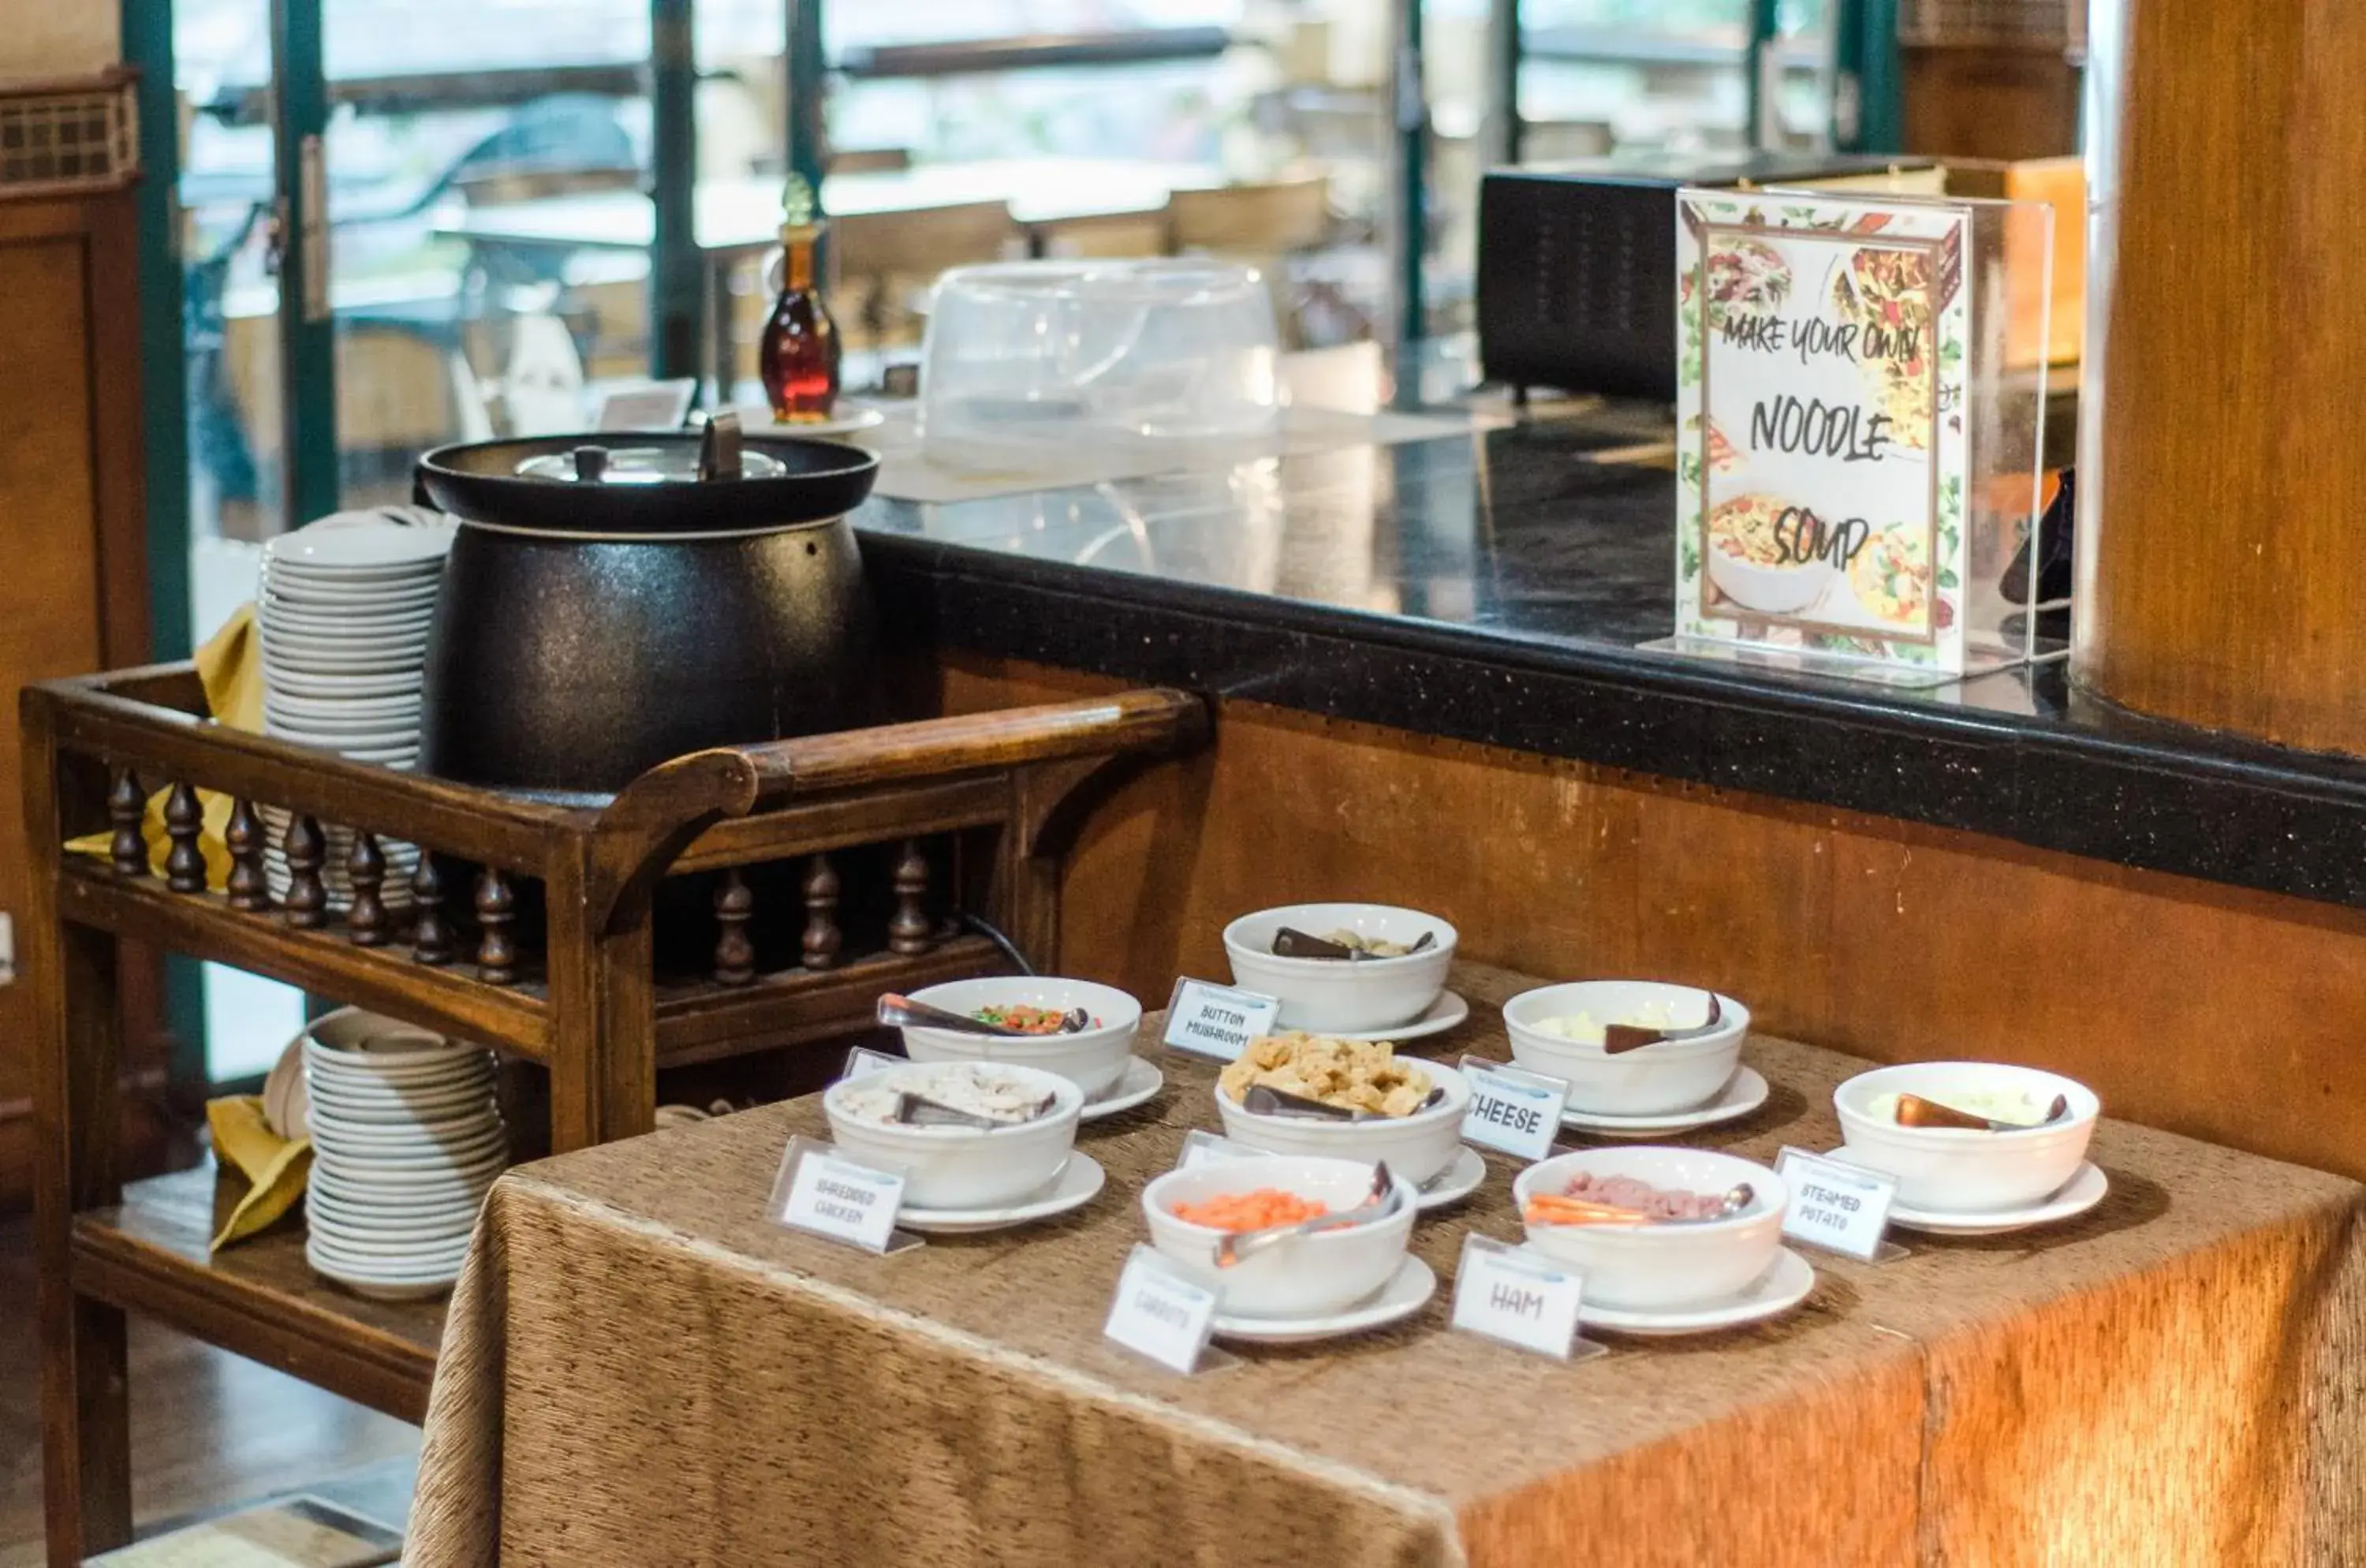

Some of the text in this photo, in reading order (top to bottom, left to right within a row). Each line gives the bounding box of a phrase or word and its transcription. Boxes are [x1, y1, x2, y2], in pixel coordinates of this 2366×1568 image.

[1722, 313, 1920, 365] MAKE YOUR OWN
[1750, 394, 1894, 461] NOODLE
[1773, 506, 1869, 572] SOUP
[1185, 1020, 1248, 1047] MUSHROOM
[1200, 1004, 1245, 1026] BUTTON
[1468, 1092, 1541, 1134] CHEESE
[1799, 1204, 1847, 1230] POTATO
[1800, 1184, 1860, 1212] STEAMED
[1490, 1282, 1543, 1320] HAM
